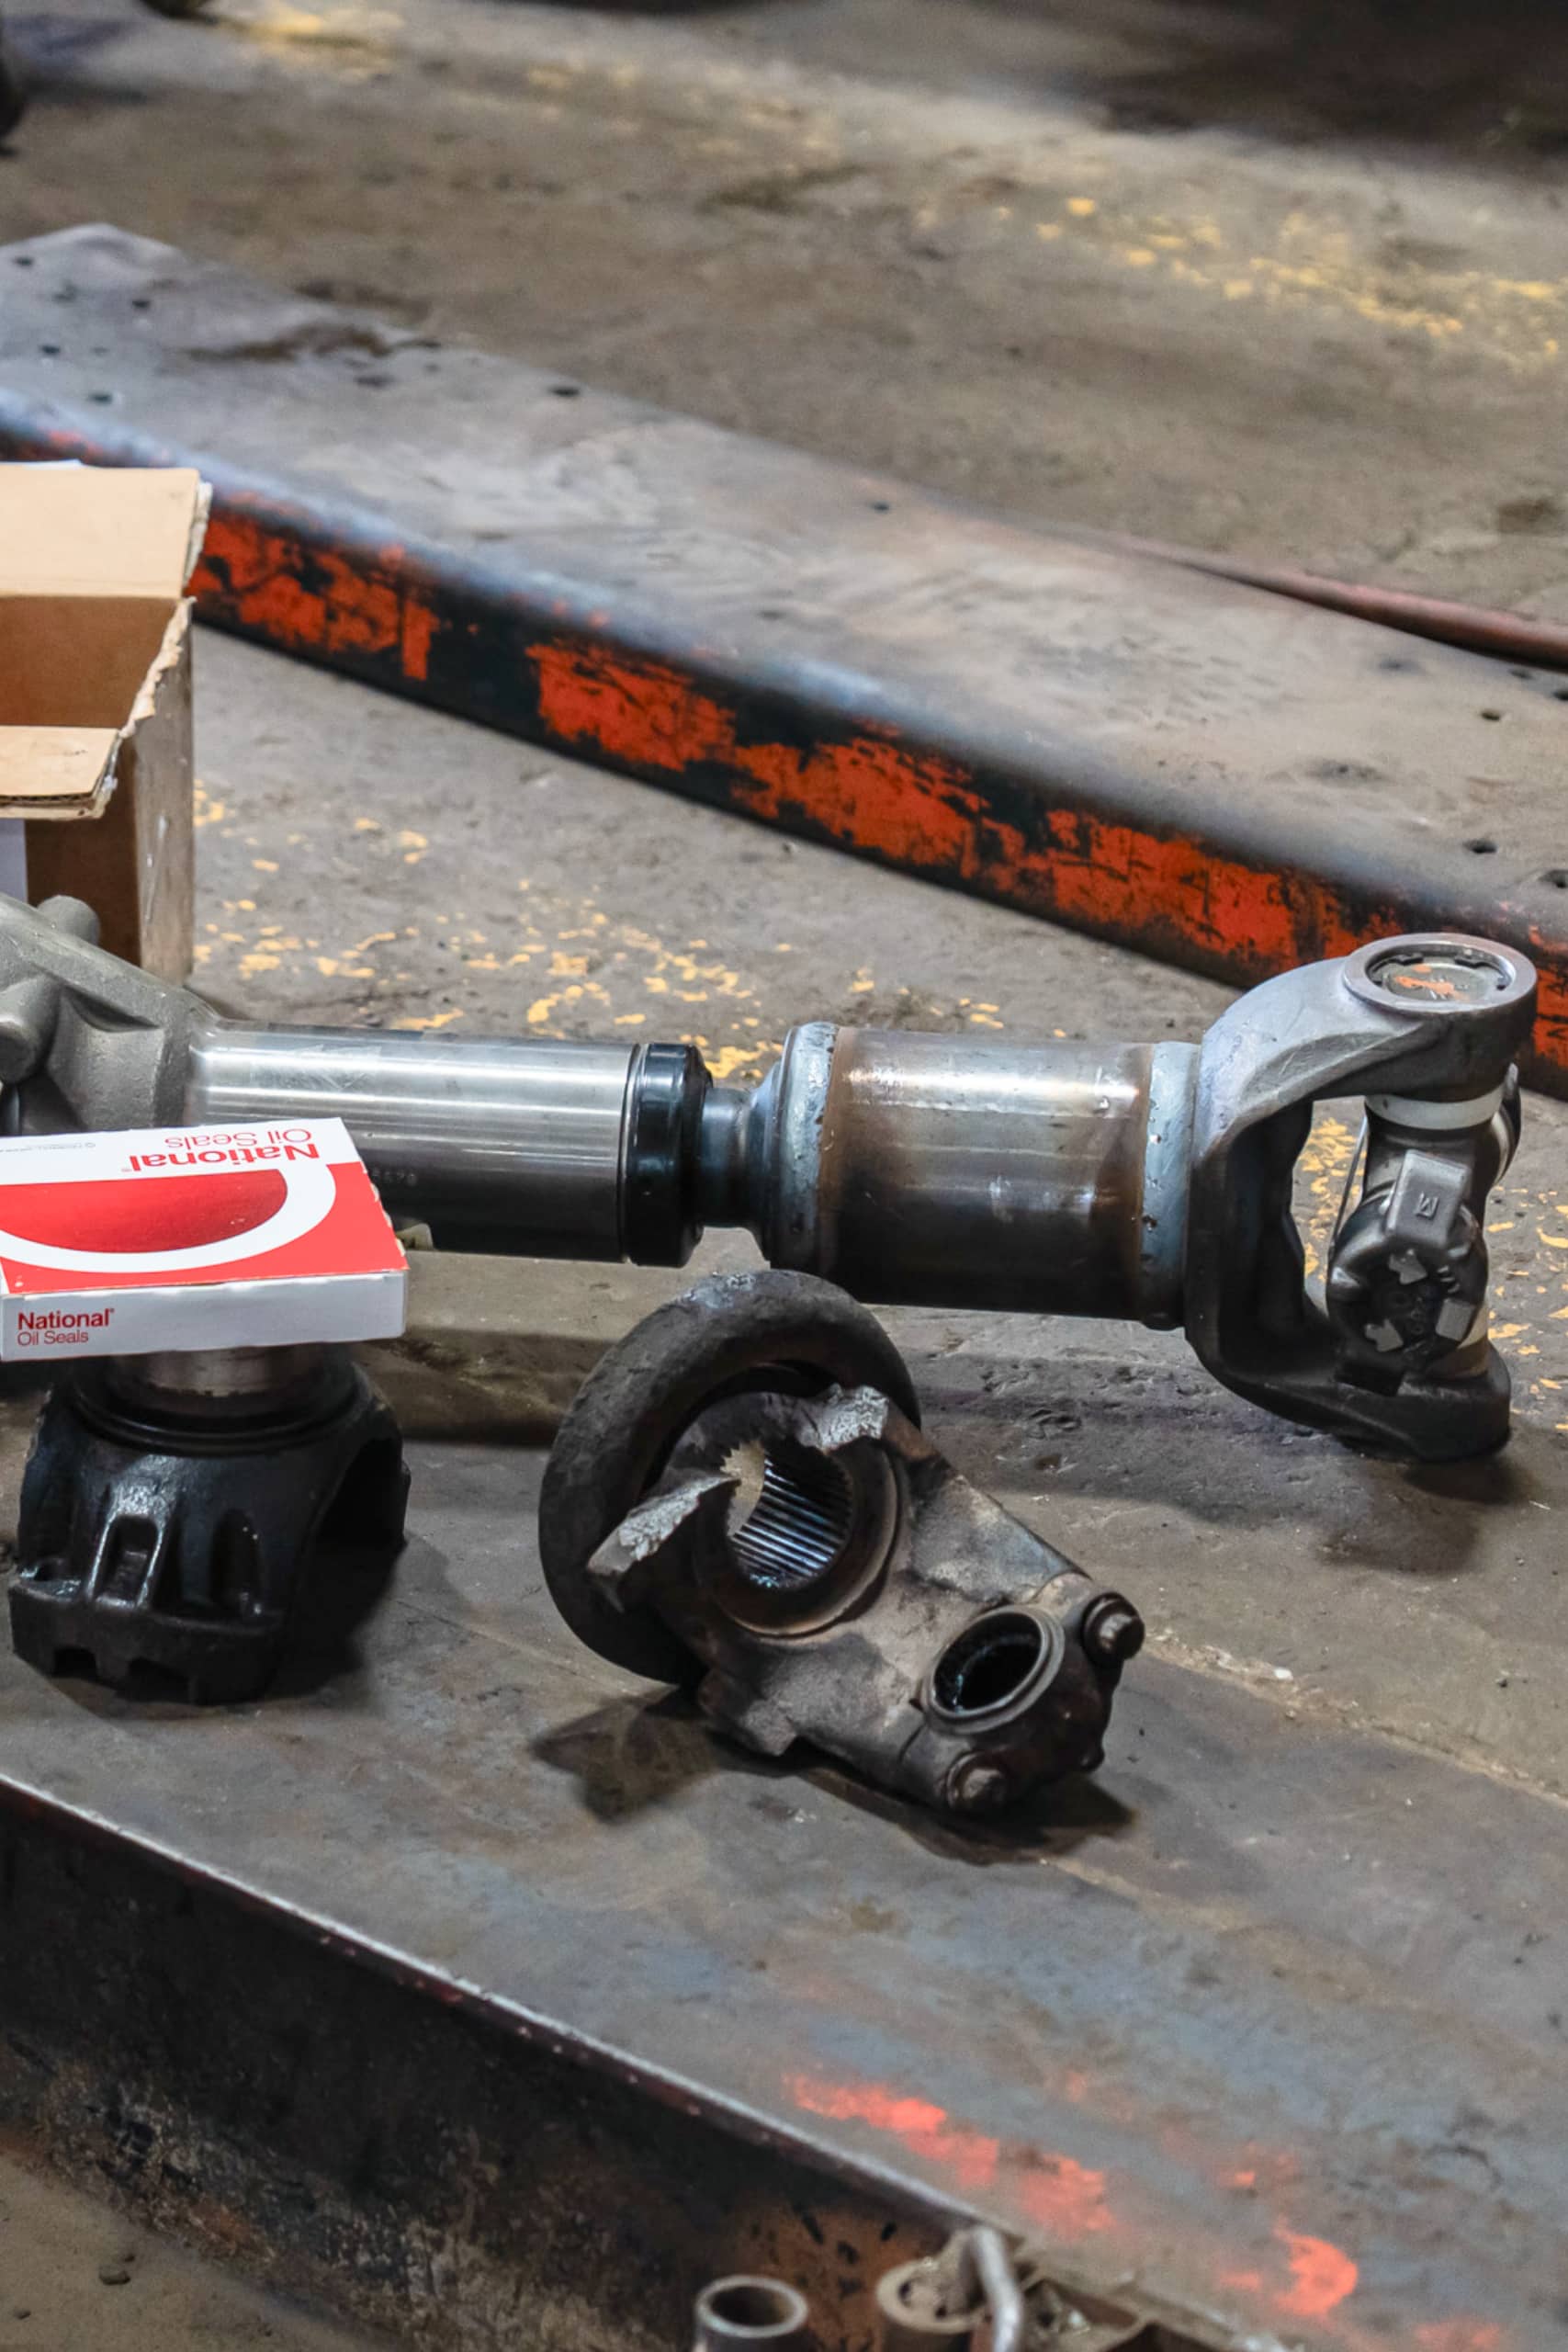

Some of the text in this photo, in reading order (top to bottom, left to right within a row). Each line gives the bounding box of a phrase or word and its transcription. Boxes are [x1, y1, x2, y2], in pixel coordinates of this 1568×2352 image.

[164, 1127, 312, 1150] Oil Seals
[128, 1143, 321, 1172] National
[17, 1307, 111, 1330] National
[17, 1329, 89, 1346] Oil Seals
